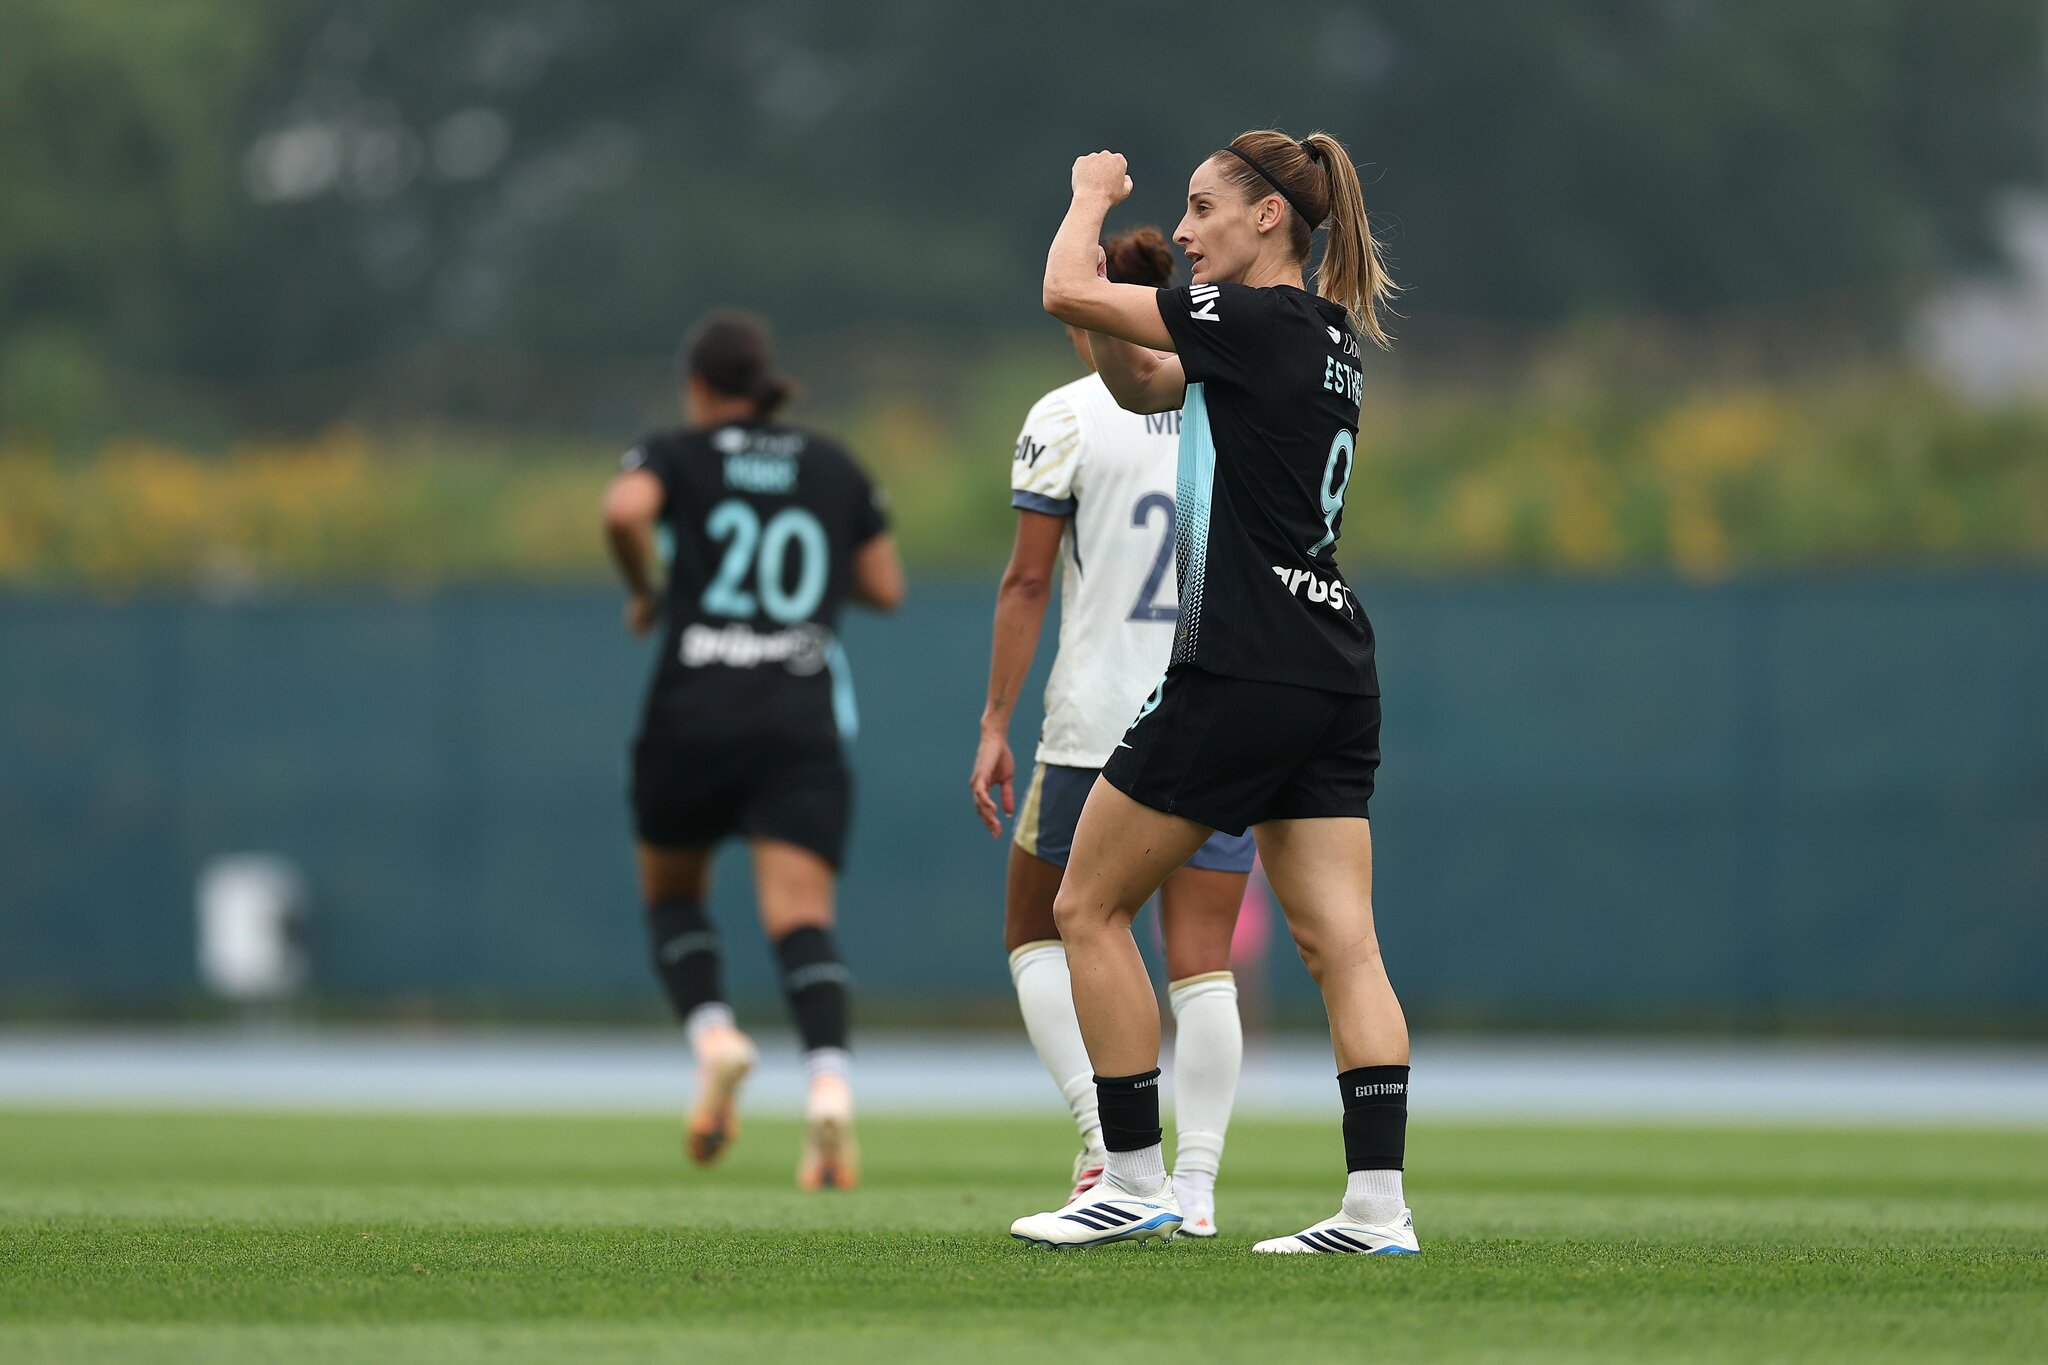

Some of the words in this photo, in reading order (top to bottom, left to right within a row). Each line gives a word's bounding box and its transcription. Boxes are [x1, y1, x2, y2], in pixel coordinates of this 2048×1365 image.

[1125, 490, 1178, 623] 2
[1307, 428, 1355, 558] 9
[700, 498, 830, 624] 20
[1355, 1083, 1404, 1098] GOTHAM
